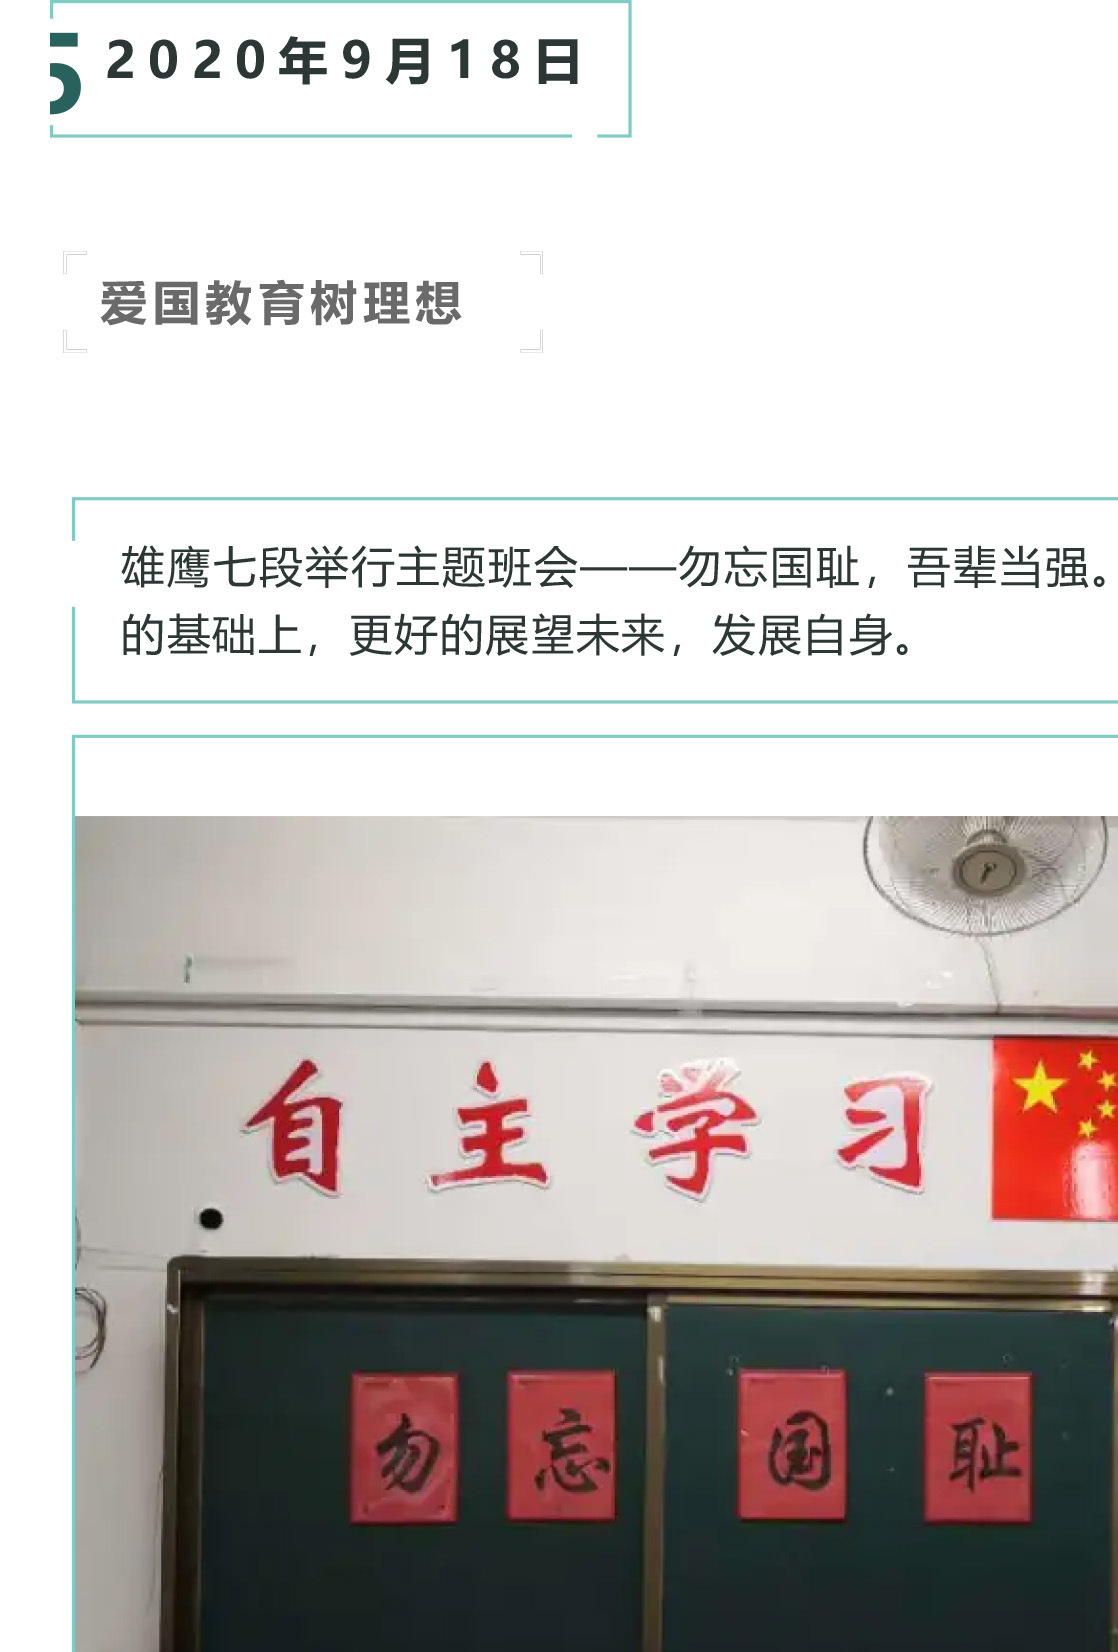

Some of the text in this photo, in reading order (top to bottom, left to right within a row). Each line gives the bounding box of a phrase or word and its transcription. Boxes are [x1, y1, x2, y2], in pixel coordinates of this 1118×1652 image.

[245, 1059, 928, 1197] 自主学习
[375, 1408, 1022, 1492] 勿忘国耻
